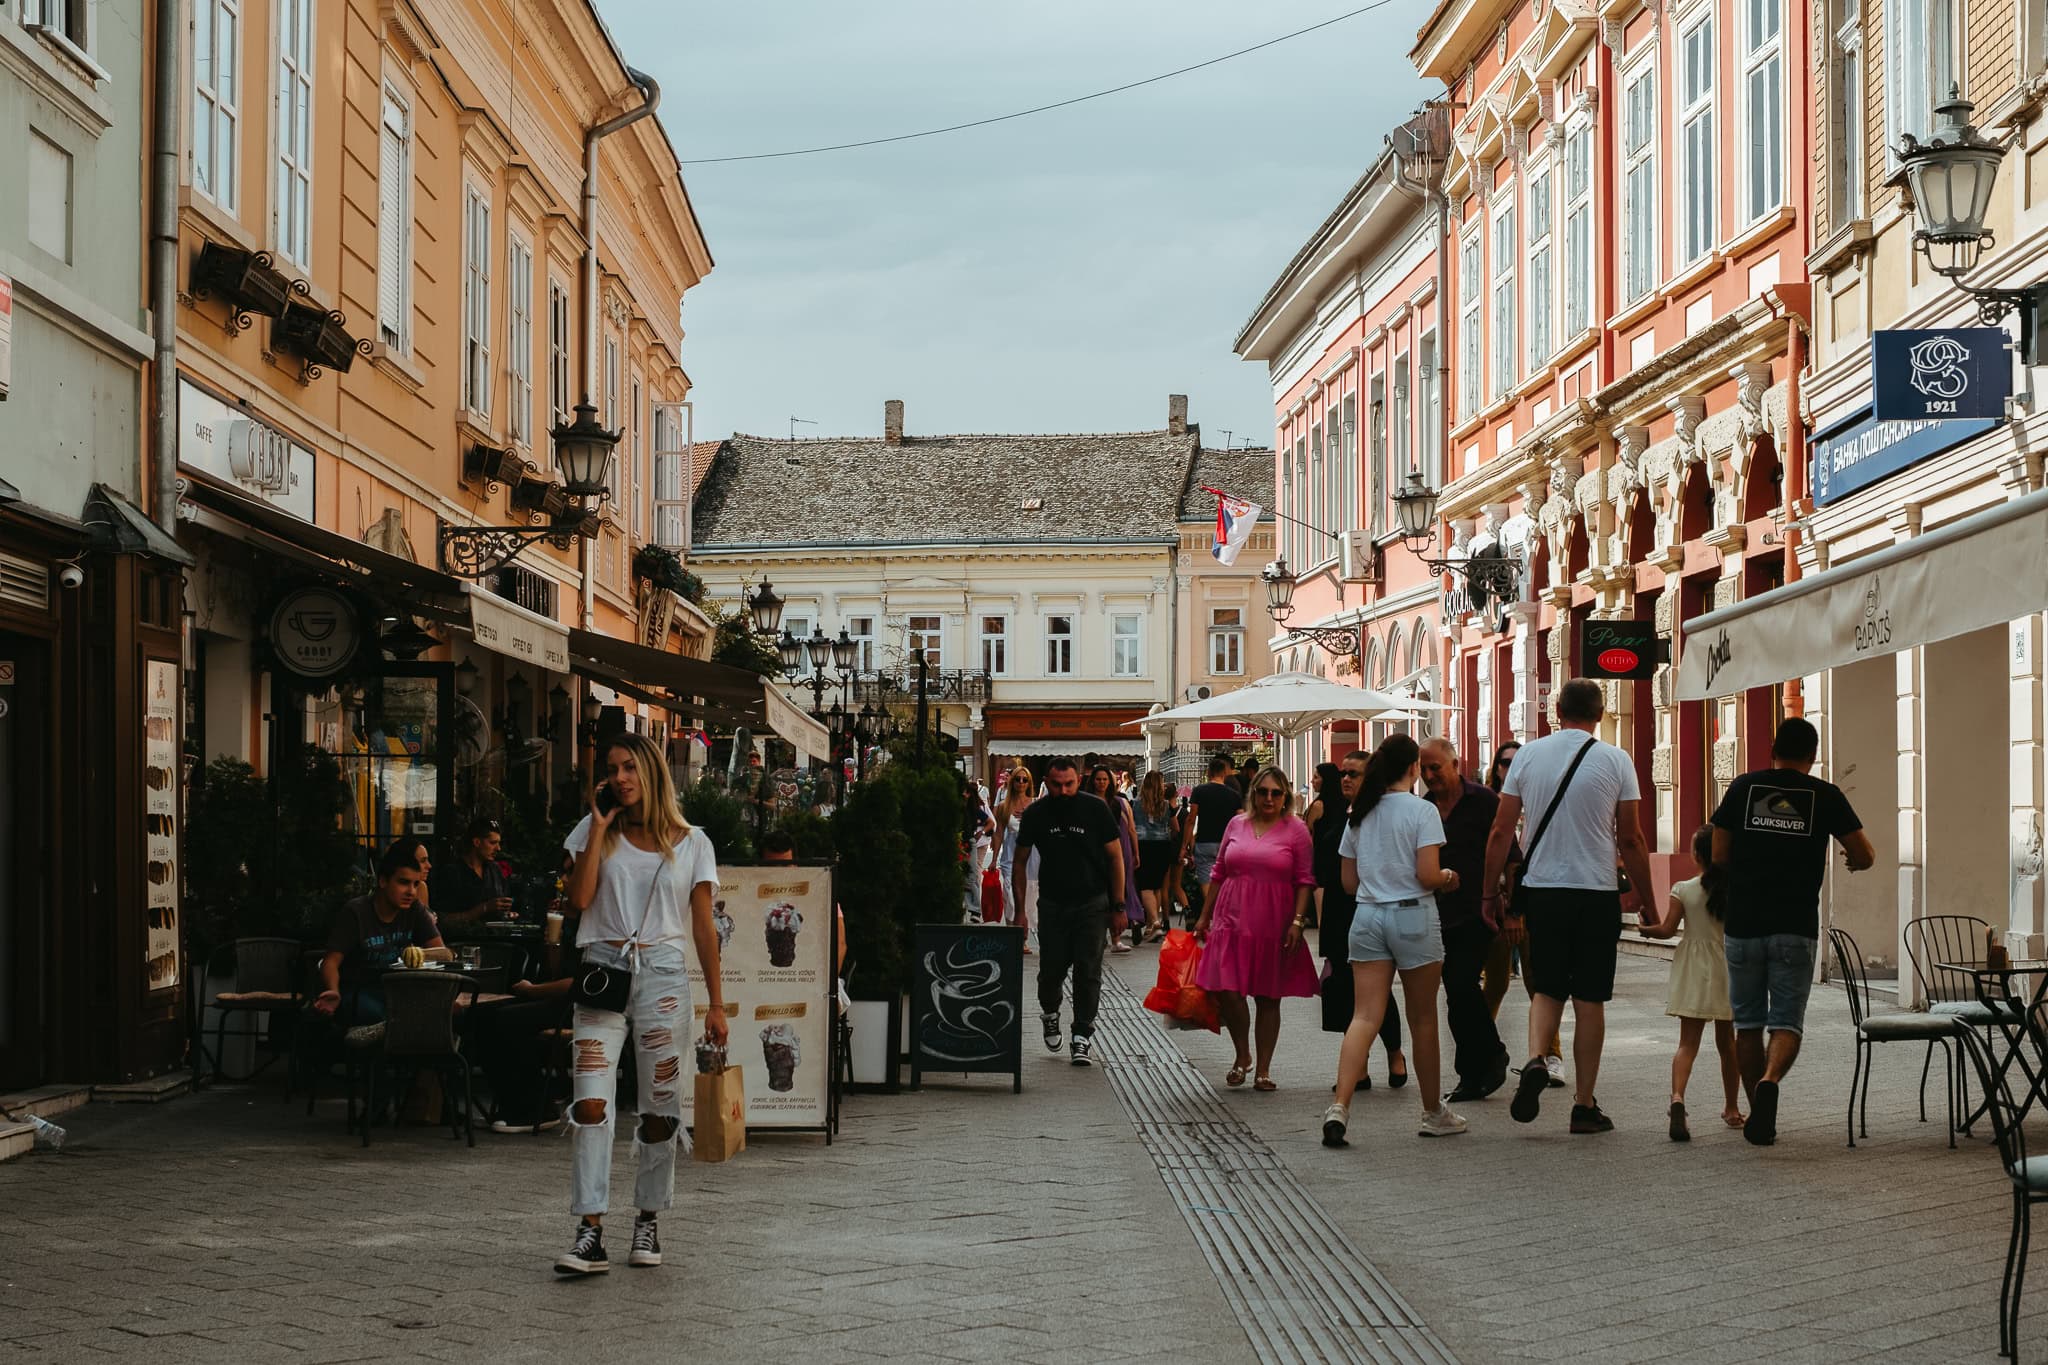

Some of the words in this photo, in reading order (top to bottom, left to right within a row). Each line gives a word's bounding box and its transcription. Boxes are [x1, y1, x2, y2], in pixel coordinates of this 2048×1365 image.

[1925, 400, 1957, 414] 1921
[195, 422, 213, 444] CAFFE
[1833, 438, 1860, 473] БАНКА
[289, 470, 299, 487] BAR
[1588, 627, 1648, 646] Paar
[1601, 656, 1634, 665] COTTON
[1752, 816, 1805, 830] QUIKSILVER
